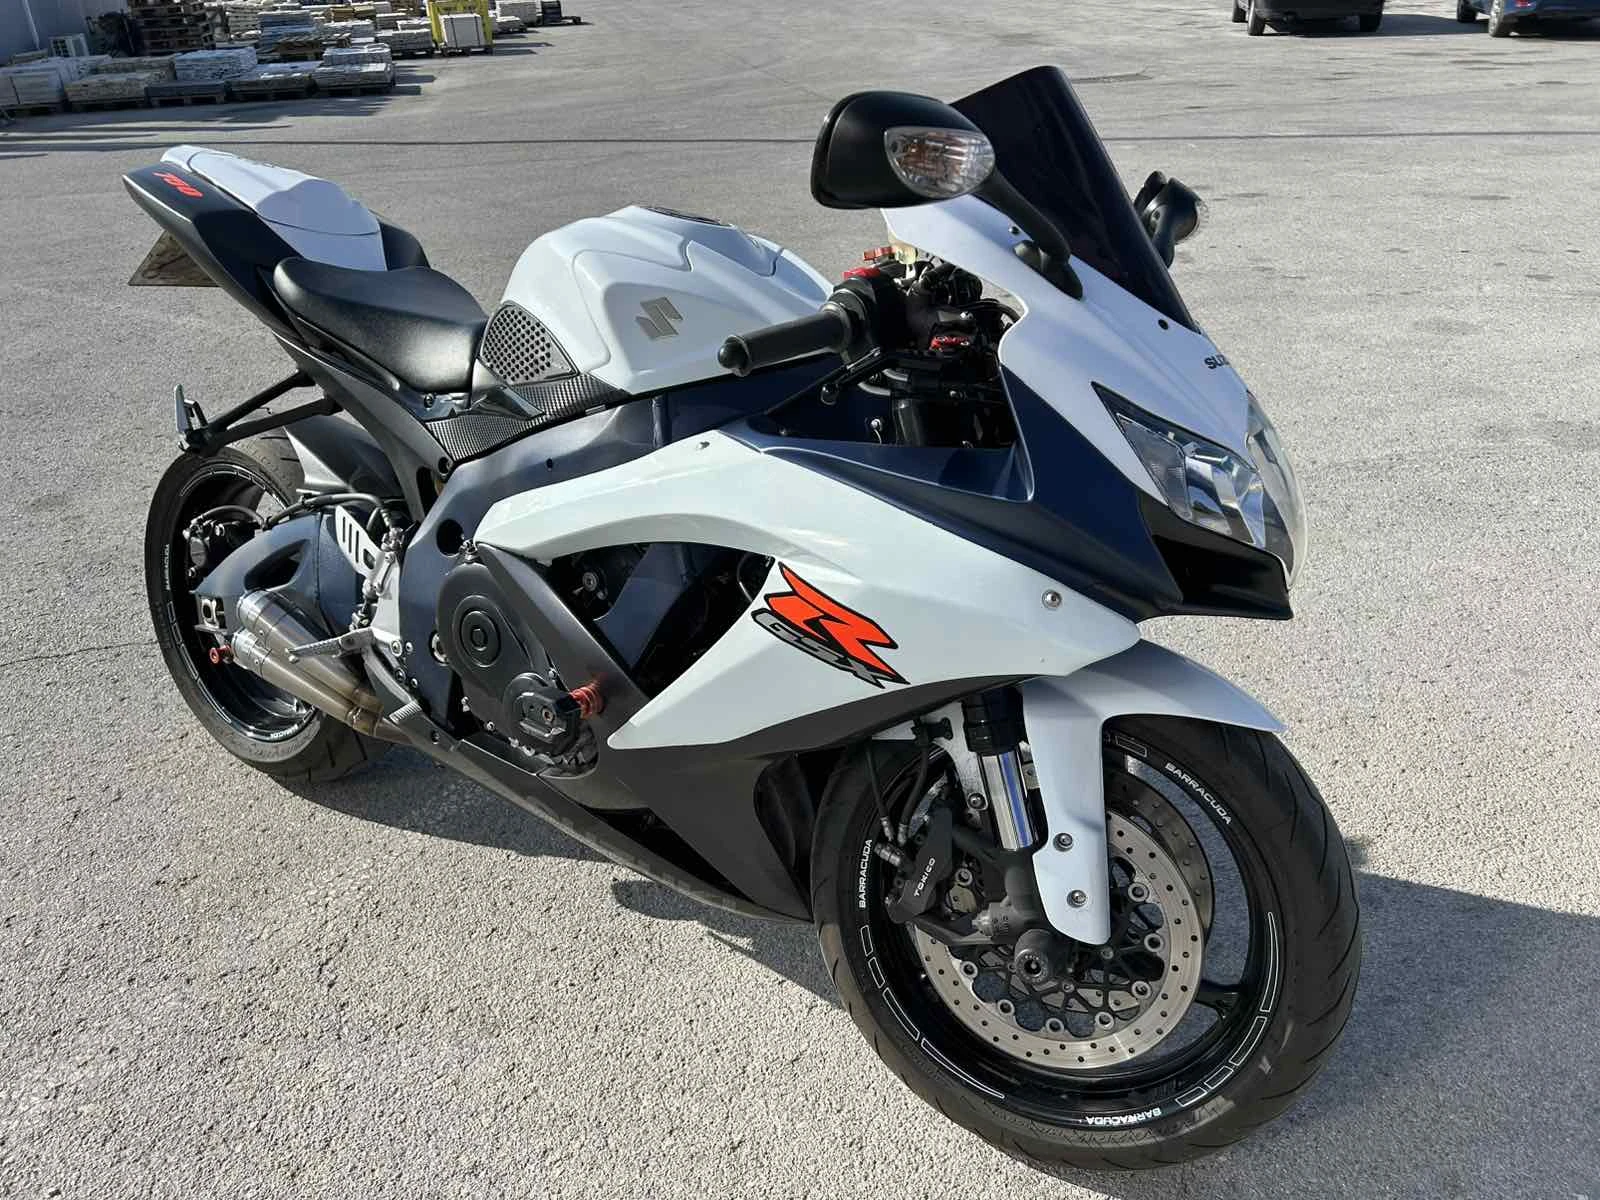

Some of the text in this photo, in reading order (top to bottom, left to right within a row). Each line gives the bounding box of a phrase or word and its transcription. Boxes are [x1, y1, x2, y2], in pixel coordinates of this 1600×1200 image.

[1164, 762, 1232, 825] BARRACUDA
[858, 839, 873, 909] BARRACUDA
[913, 857, 936, 897] TOKICO
[1084, 1107, 1162, 1126] BARRACUDA
